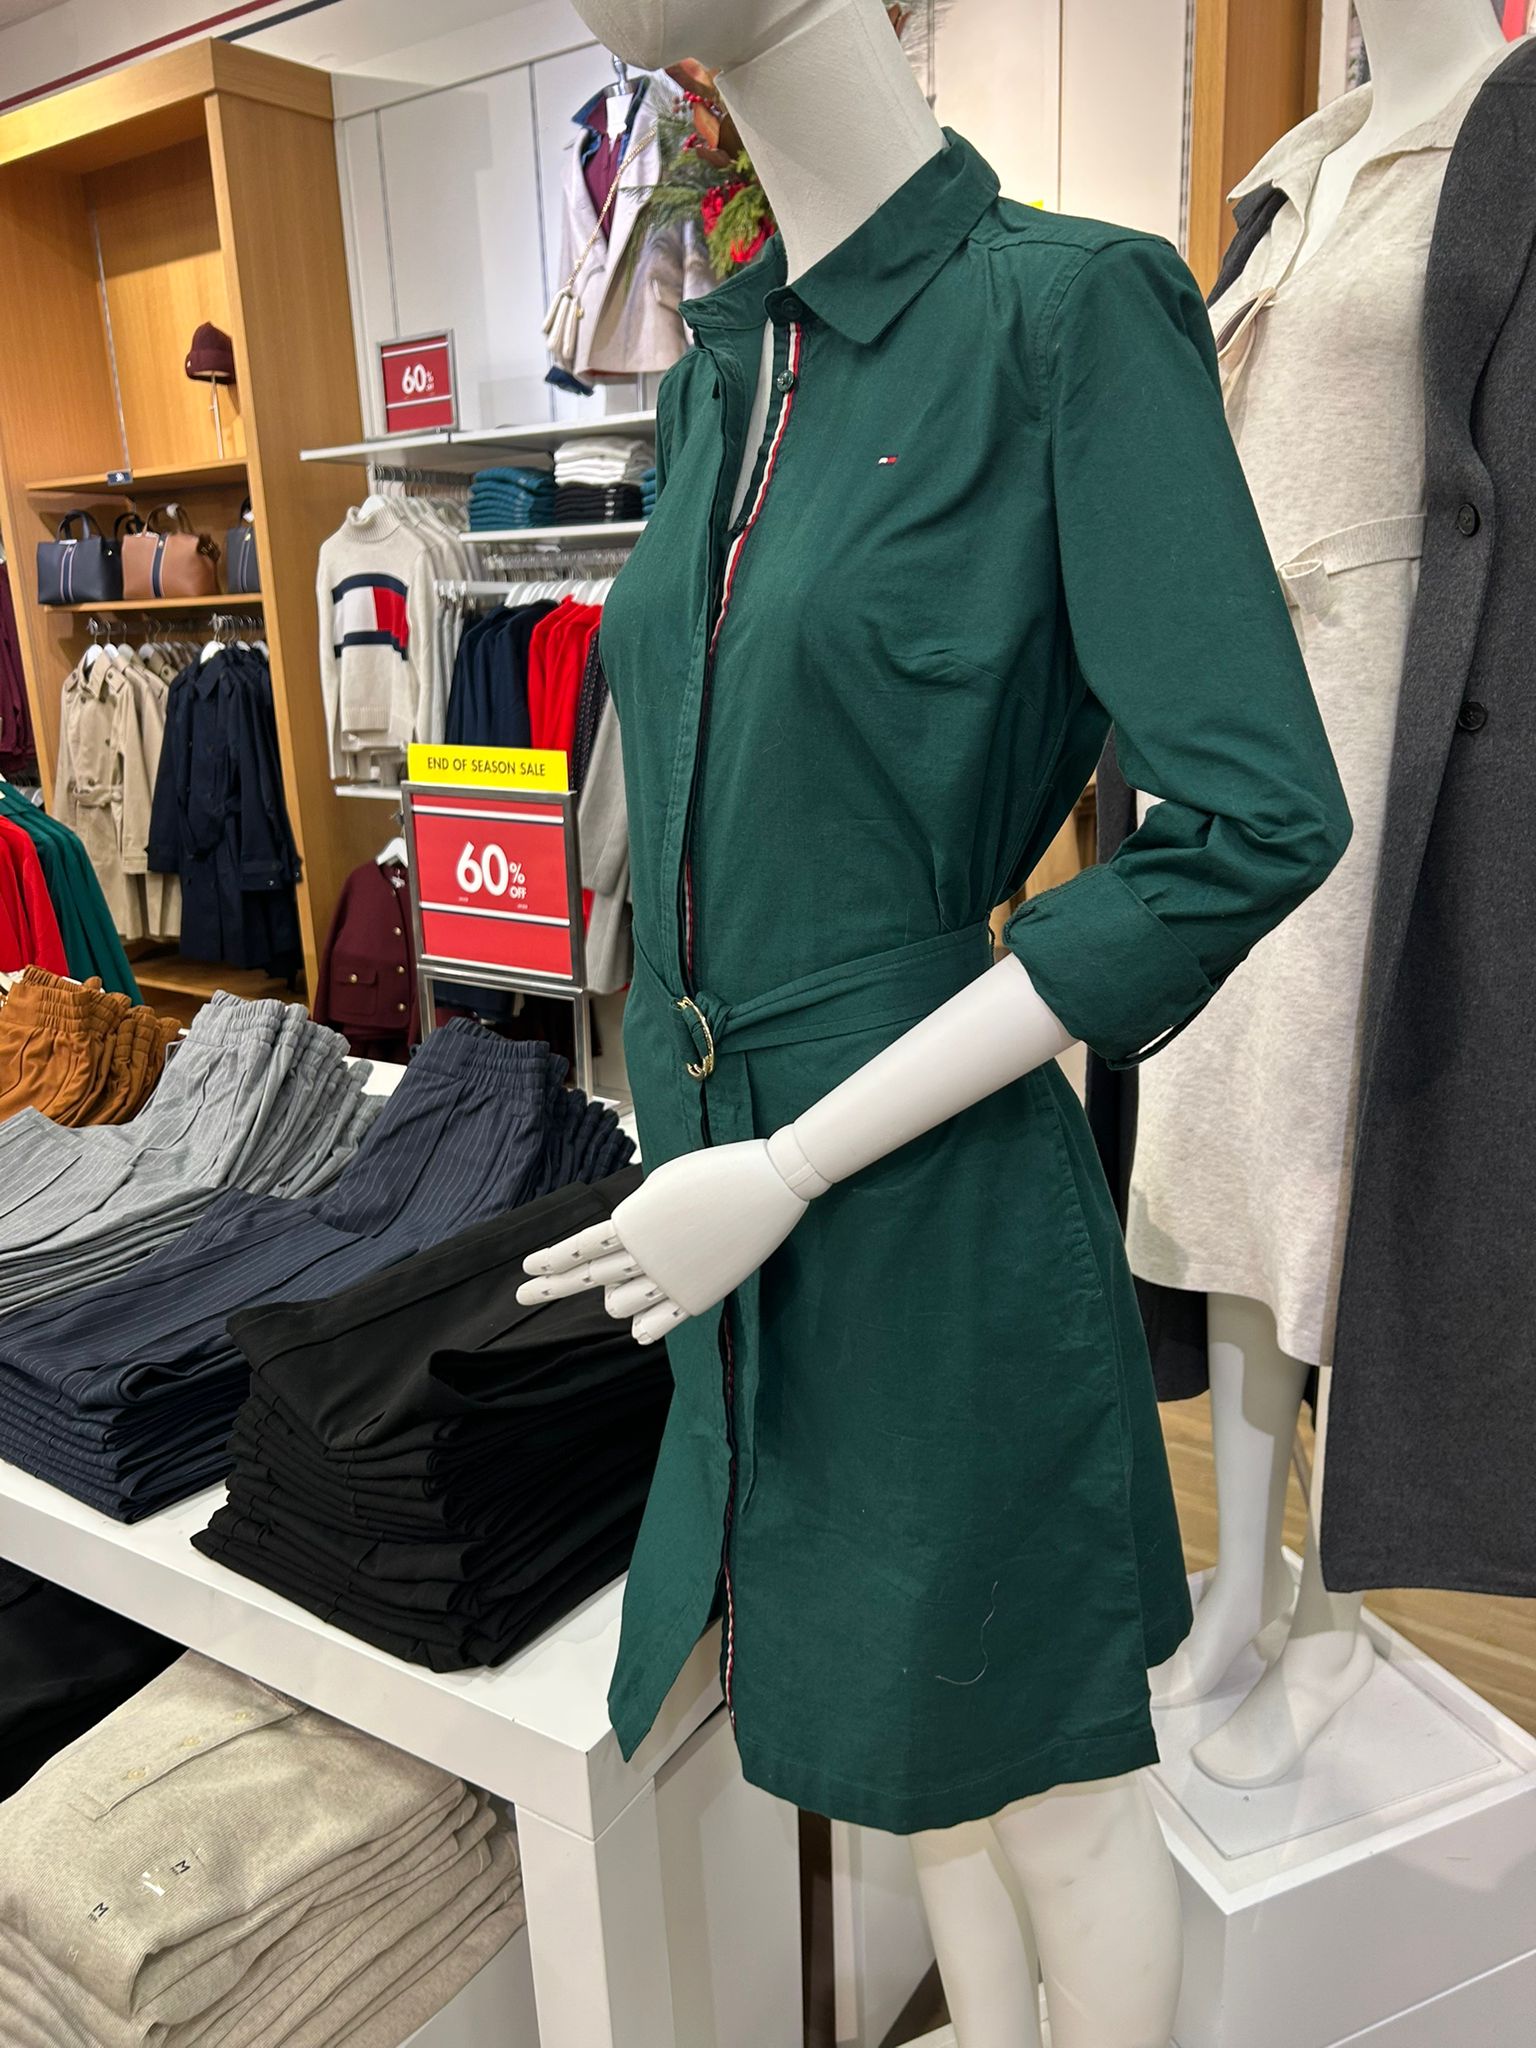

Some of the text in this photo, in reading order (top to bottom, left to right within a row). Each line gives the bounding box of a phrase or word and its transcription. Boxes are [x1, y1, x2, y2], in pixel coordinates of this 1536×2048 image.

[428, 757, 545, 776] END OF SEASON SALE
[509, 886, 527, 900] OFF
[175, 1860, 191, 1874] M
[93, 1902, 109, 1918] M
